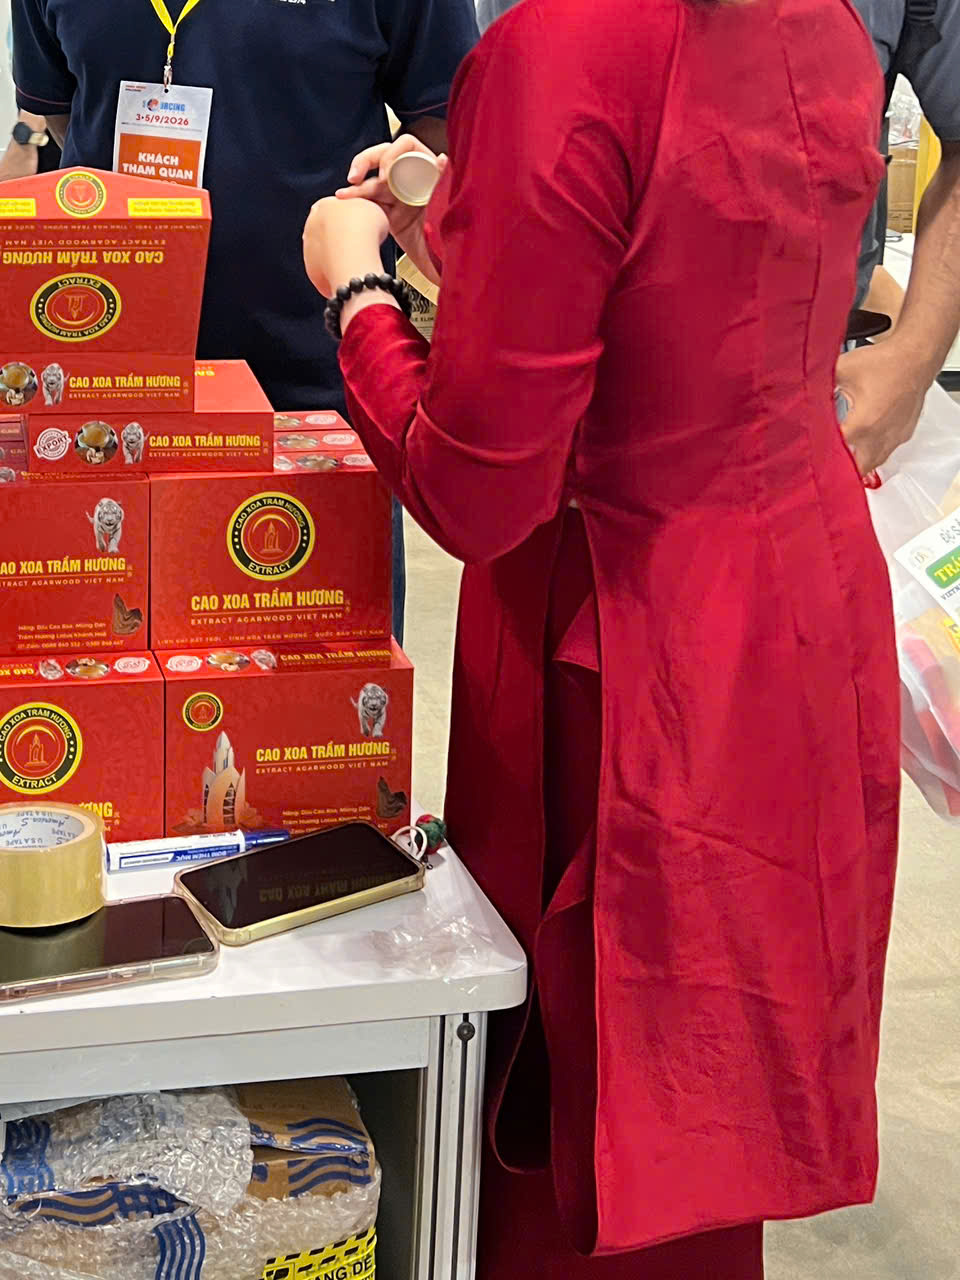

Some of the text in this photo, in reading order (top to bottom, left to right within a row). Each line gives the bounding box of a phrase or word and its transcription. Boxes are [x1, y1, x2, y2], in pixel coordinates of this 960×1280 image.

[191, 595, 219, 611] CAO
[222, 593, 250, 609] XOA
[296, 589, 344, 606] HƯƠNG
